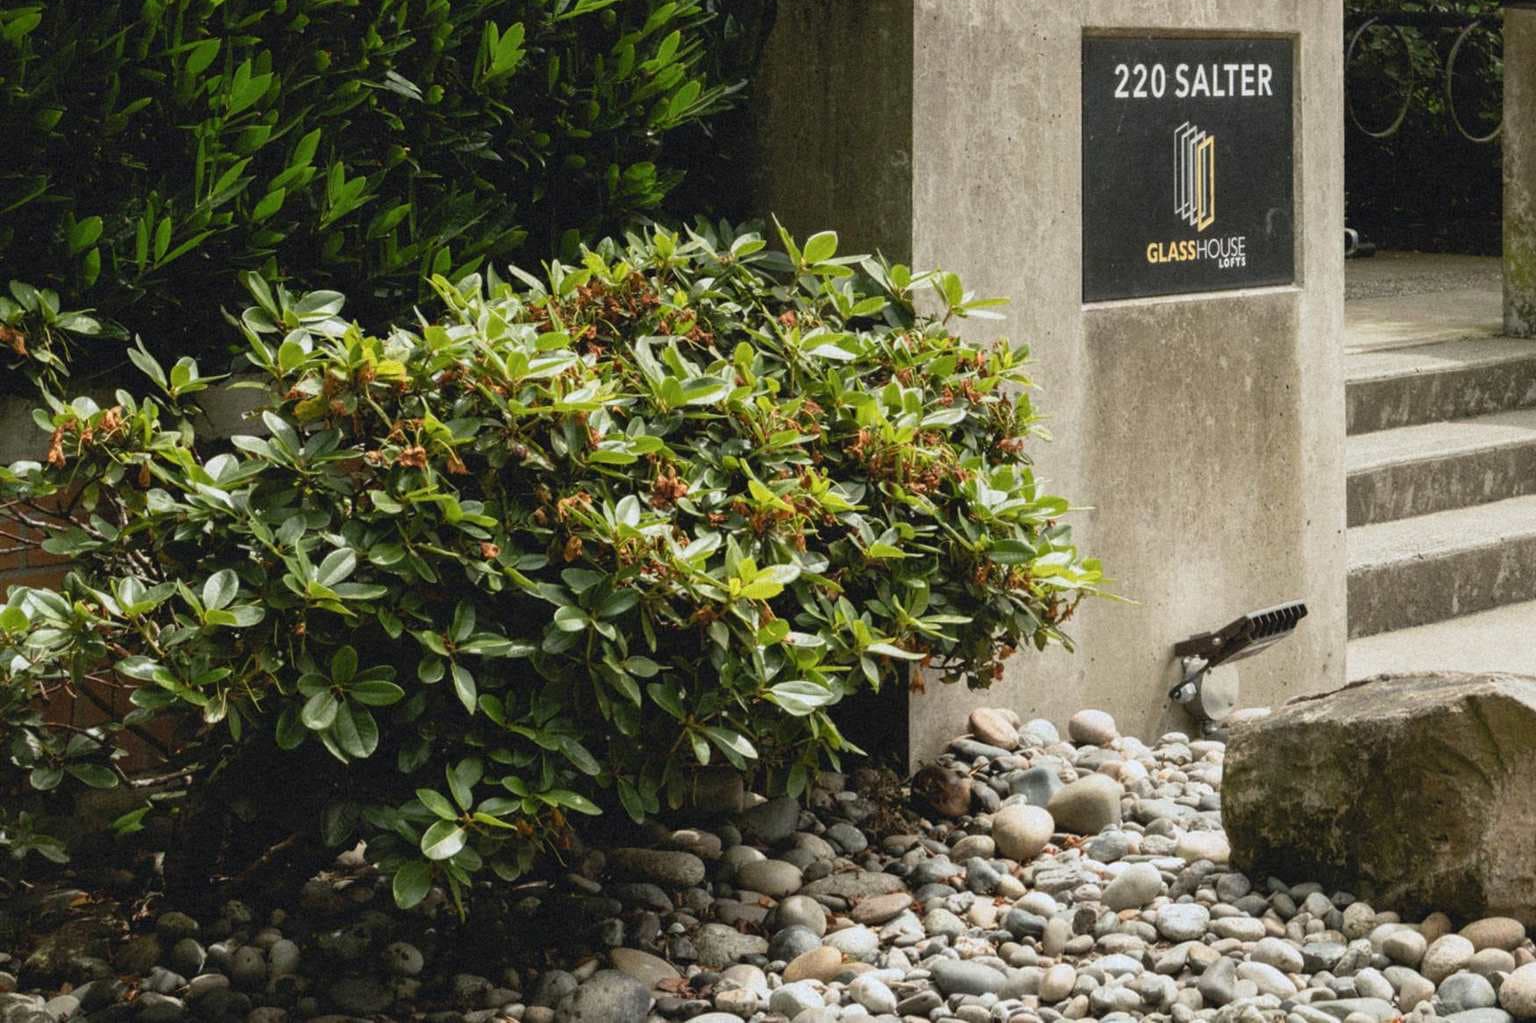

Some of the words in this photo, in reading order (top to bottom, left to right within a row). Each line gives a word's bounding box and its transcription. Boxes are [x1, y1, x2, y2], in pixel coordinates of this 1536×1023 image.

[1114, 63, 1166, 98] 220
[1175, 63, 1273, 98] SALTER
[1147, 236, 1246, 263] GLASSHOUSE
[1218, 257, 1246, 268] LOFTS
